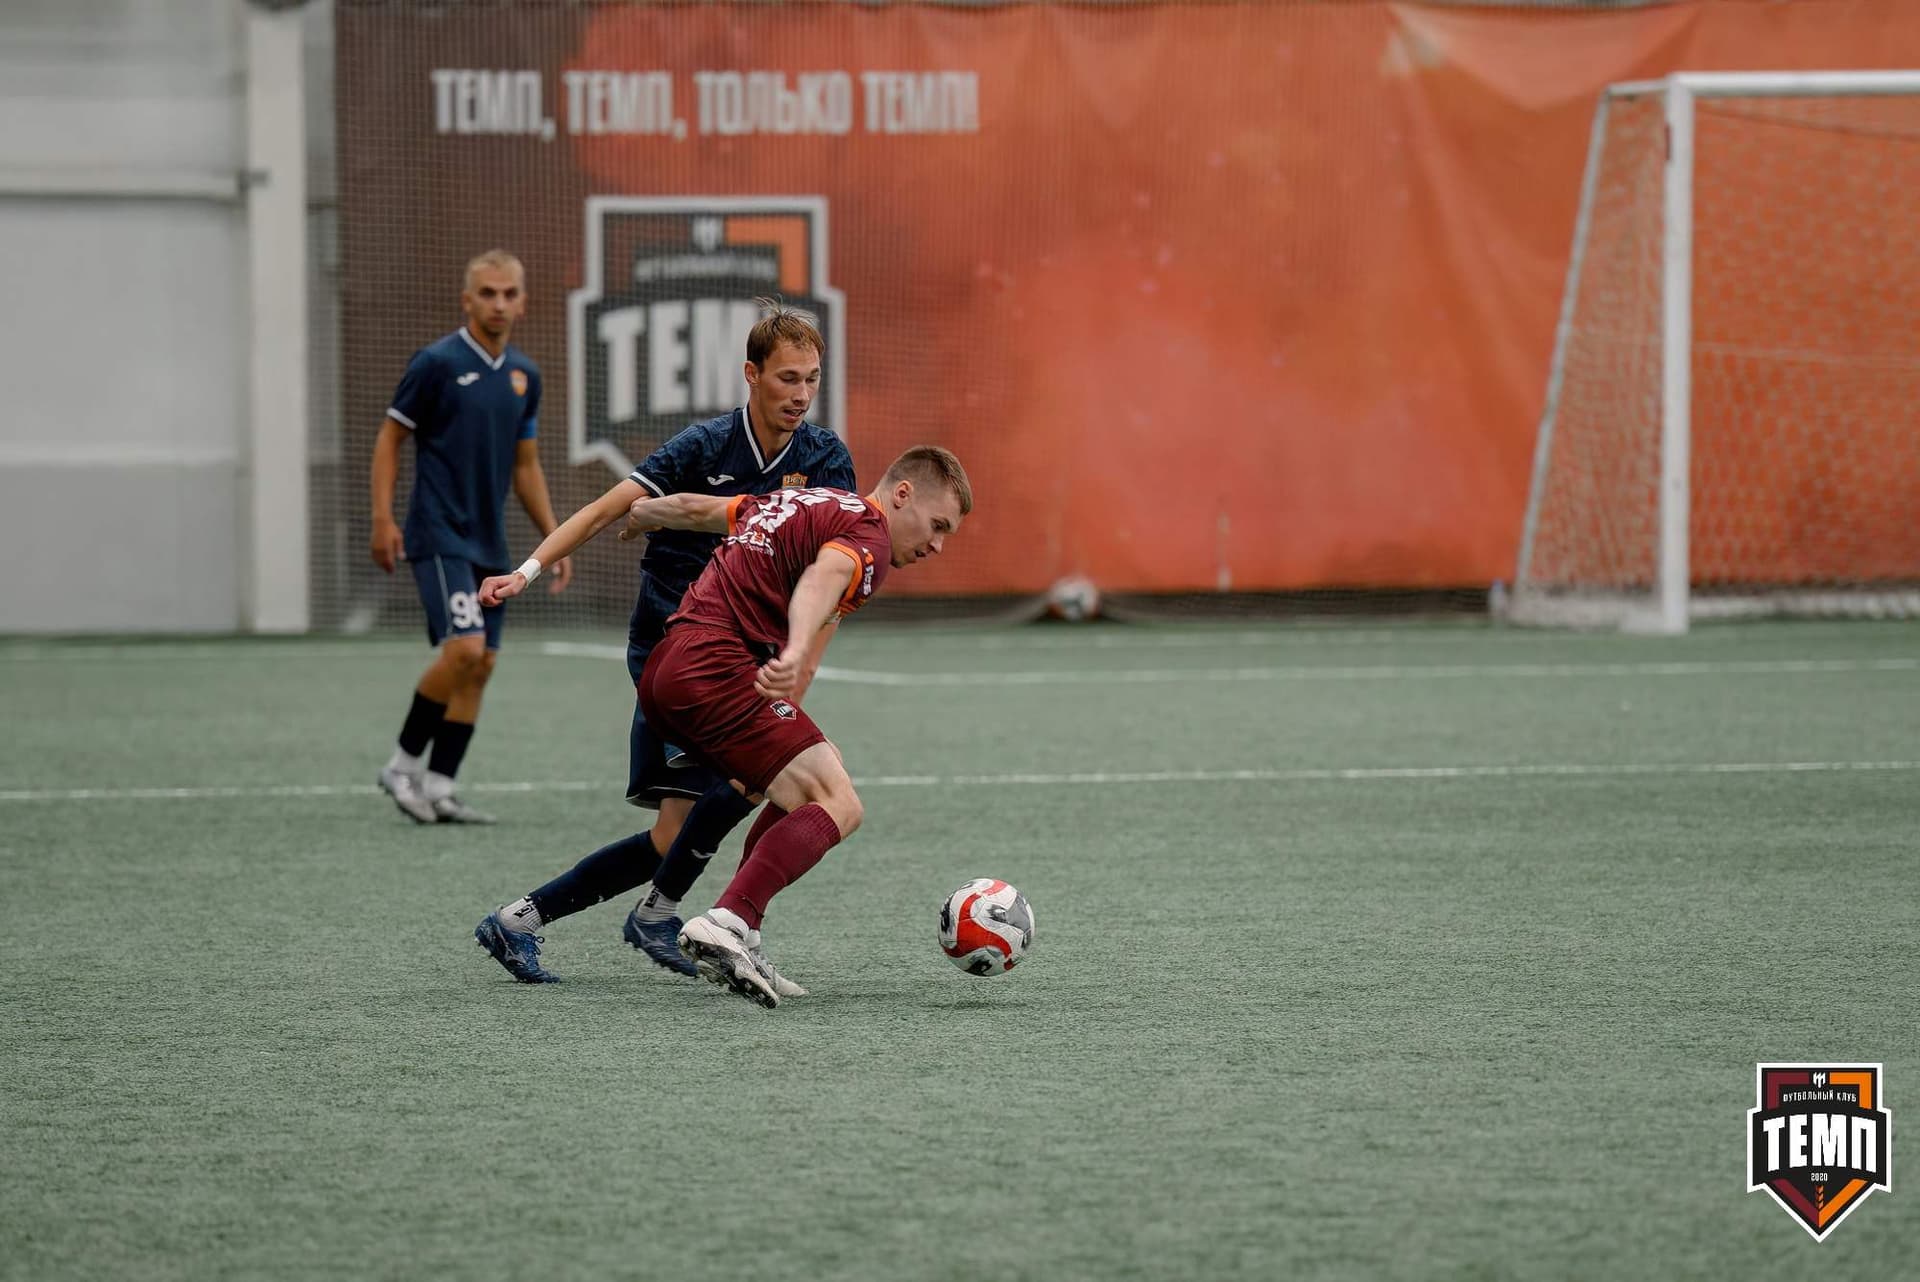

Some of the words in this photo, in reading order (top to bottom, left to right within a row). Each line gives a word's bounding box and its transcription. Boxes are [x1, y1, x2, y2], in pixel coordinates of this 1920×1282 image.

[432, 69, 556, 140] ТЕМП,
[563, 70, 687, 139] ТЕМП,
[694, 70, 854, 135] ТОЛЬКО
[861, 70, 979, 135] ТЕМП!
